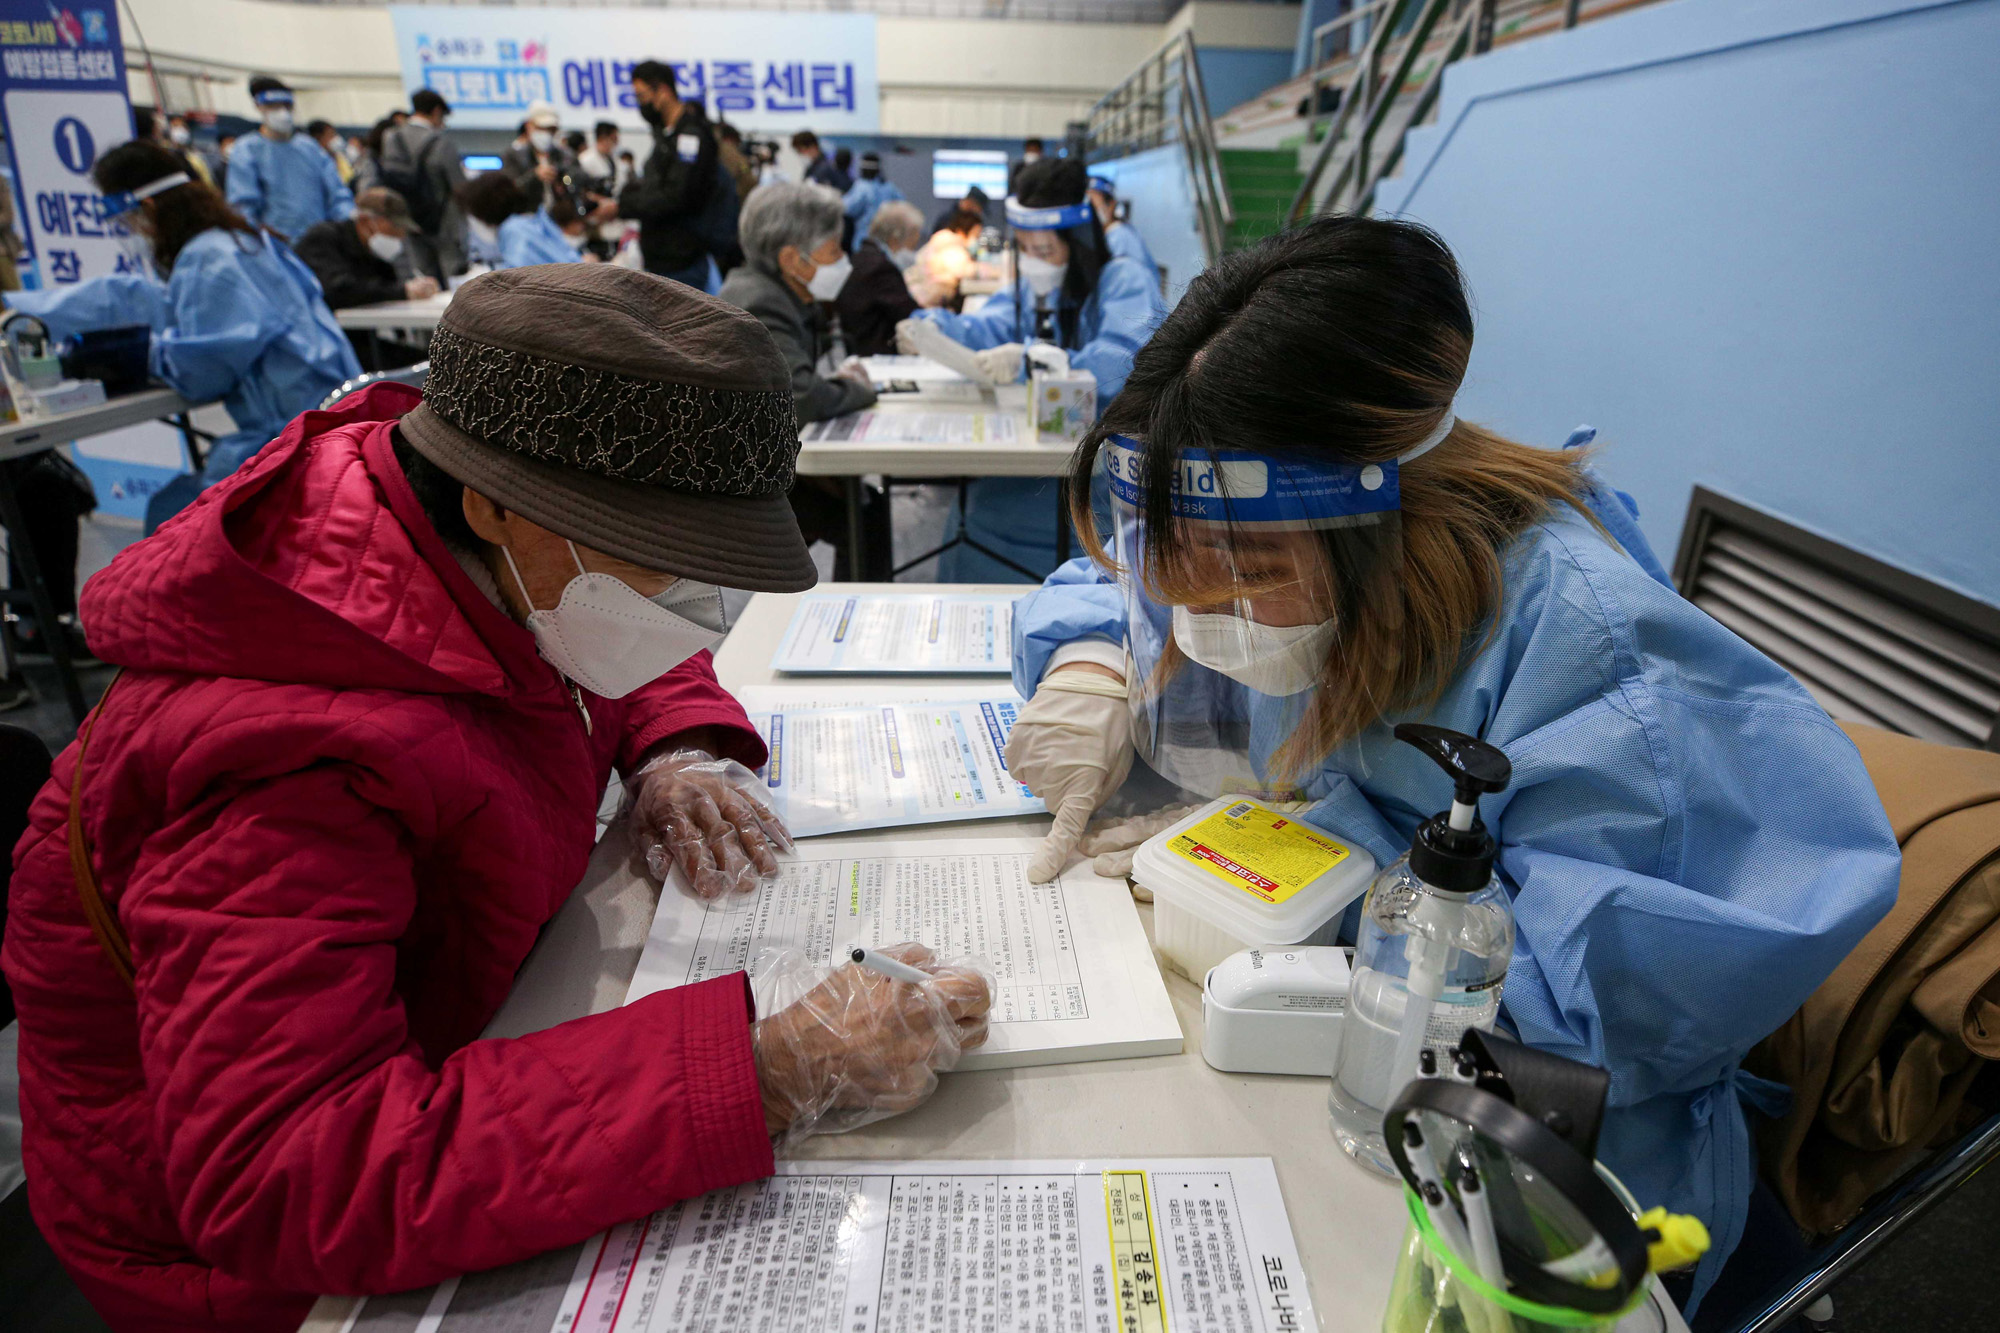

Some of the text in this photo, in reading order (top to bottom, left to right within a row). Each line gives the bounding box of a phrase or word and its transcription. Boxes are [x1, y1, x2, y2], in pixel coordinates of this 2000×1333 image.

[4, 49, 117, 80] 예방접종센터
[1306, 836, 1334, 850] Firson
[714, 1193, 733, 1220] 이전에
[743, 1200, 762, 1238] 코로나19
[796, 1191, 811, 1210] 최근
[828, 1191, 843, 1220] 이전과
[999, 1193, 1011, 1232] 개인정보
[1015, 1193, 1028, 1232] 개인정보
[1031, 1193, 1044, 1231] 개인정보
[1109, 1188, 1126, 1227] 전화번호
[691, 1225, 708, 1244] 받은
[752, 1191, 780, 1265] 있다면 접종일을
[791, 1214, 807, 1235] 14일
[822, 1224, 837, 1254] 다르게
[899, 1181, 919, 1296] 3. 코로나19 예방접종 후
[965, 1193, 979, 1279] 사전 확인하는 것에
[981, 1181, 995, 1306] 1. 코로나19 예방접종 전에
[1046, 1181, 1064, 1287] 및 민감정보를 수집하고
[1183, 1199, 1210, 1288] 코로나19 예방접종을
[684, 1249, 701, 1269] 적이
[698, 1242, 720, 1278] 알레르기
[719, 1237, 737, 1265] 치료를
[737, 1241, 753, 1261] 백신
[759, 1191, 796, 1310] 코로나19 백신을 접종받은
[787, 1241, 802, 1261] 이내
[793, 1191, 827, 1317] 코로나19 감염을 진단 받은
[880, 1194, 903, 1311] 문자 수신에 동의하지 않는
[912, 1194, 933, 1331] 문자 수신에 동의하지 않는 경우
[928, 1181, 949, 1324] 2. 코로나19 예방접종의 다음 접종
[947, 1189, 964, 1303] 예방접종 내역의 사전확인에
[999, 1237, 1012, 1258] 보유
[1166, 1198, 1198, 1312] 대리인, 보호자) 확인란에
[1198, 1198, 1228, 1298] 충분히 제공받았으며,
[644, 1265, 663, 1287] 앓고
[712, 1269, 729, 1289] 받은
[731, 1264, 748, 1284] 접종
[817, 1260, 832, 1281] 오늘
[999, 1262, 1012, 1273] 및
[1064, 1232, 1082, 1304] 예방 및 관리에
[1092, 1263, 1108, 1307] 예방접종
[1116, 1253, 1136, 1311] (집) 서울시
[668, 1273, 695, 1323] 있습니까?
[707, 1294, 724, 1314] 적이
[730, 1290, 742, 1298] 후
[824, 1290, 844, 1330] 입니까?
[1260, 1254, 1299, 1333] 코로나바
